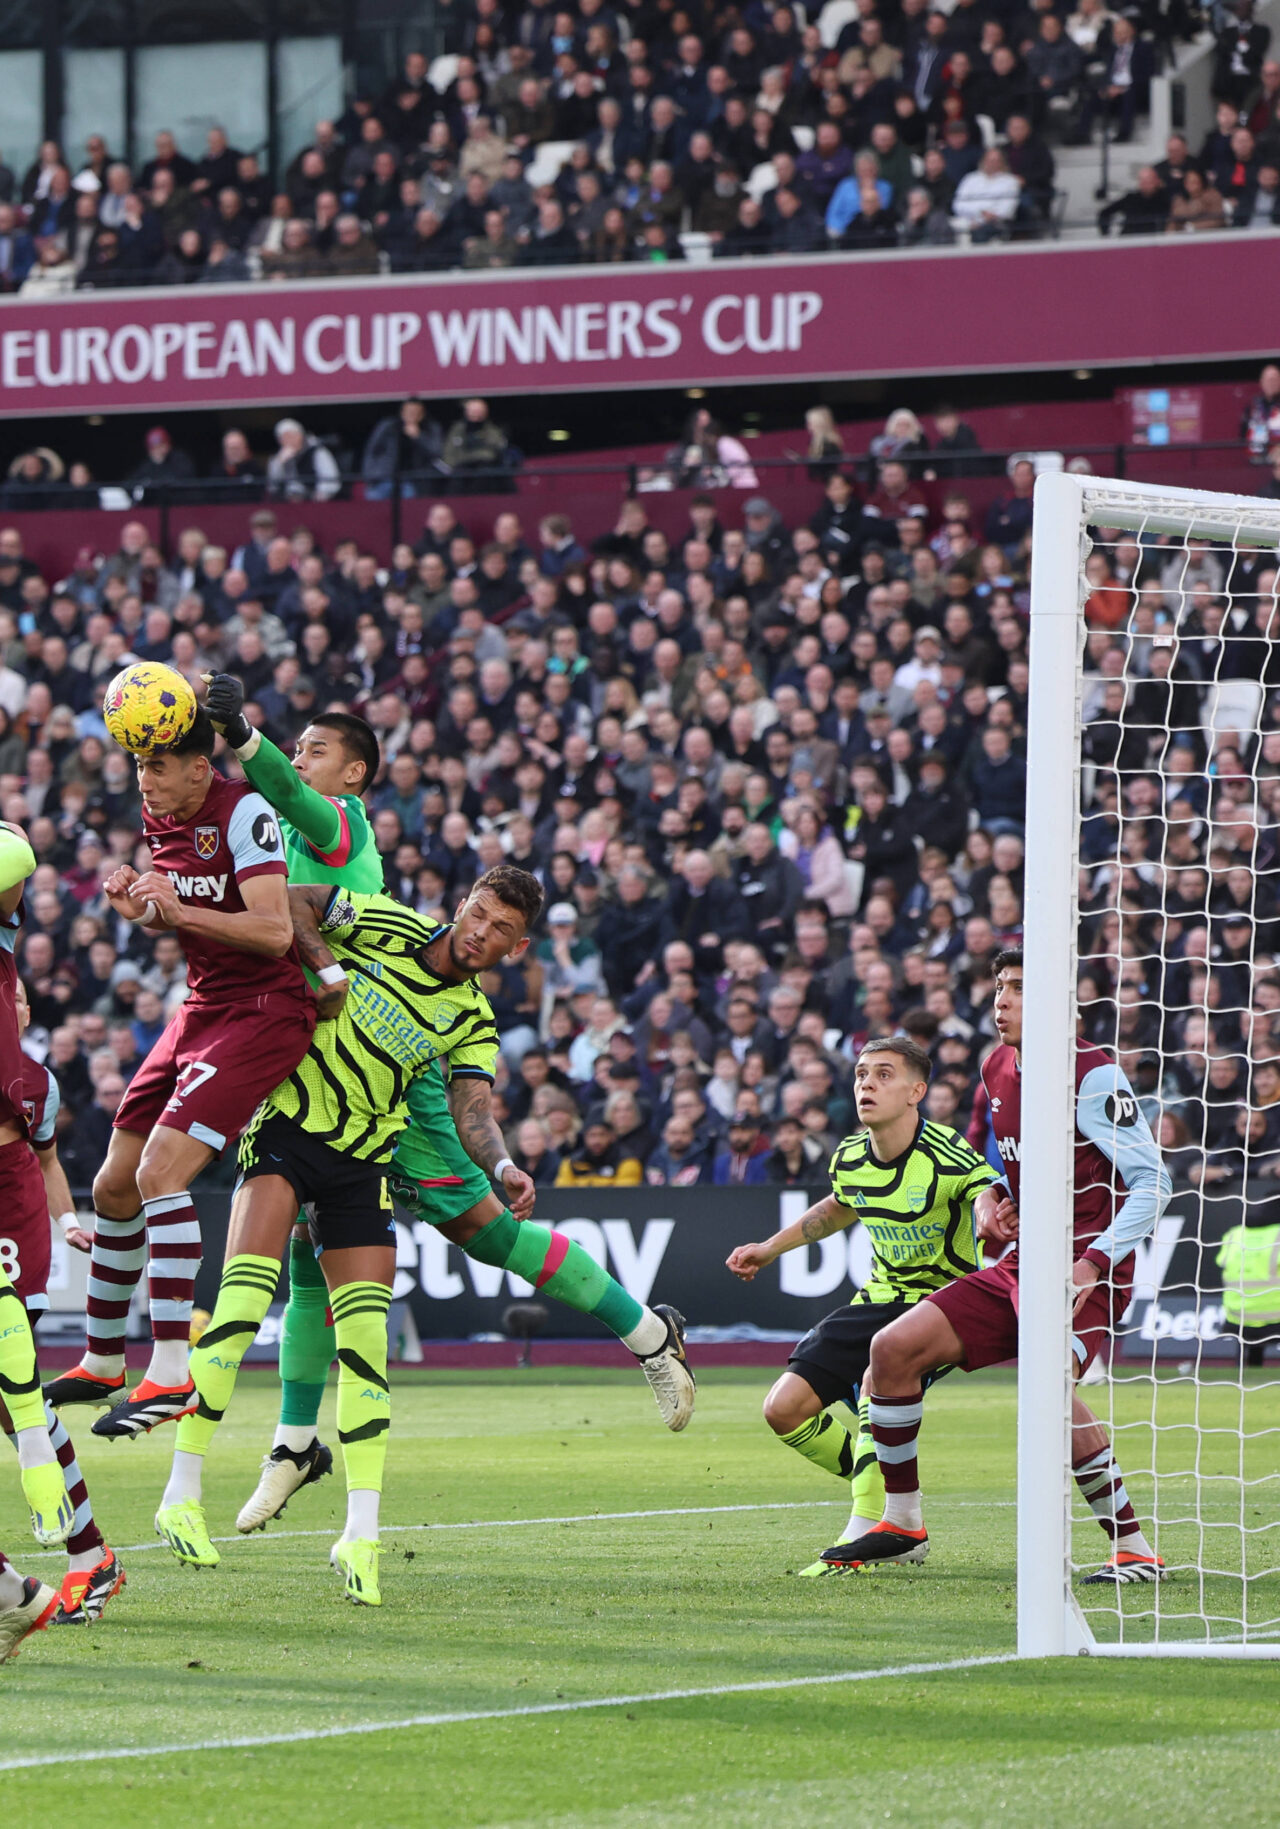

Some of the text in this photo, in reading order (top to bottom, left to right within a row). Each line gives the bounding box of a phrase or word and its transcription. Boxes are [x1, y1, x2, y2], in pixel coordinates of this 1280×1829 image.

[1, 316, 296, 389] EUROPEAN
[303, 310, 421, 375] CUP
[701, 291, 823, 355] CUP
[258, 821, 277, 846] JD
[350, 972, 439, 1061] Emirates
[351, 1004, 375, 1030] FLY
[373, 1027, 415, 1065] BETTER
[893, 1242, 938, 1261] BETTER
